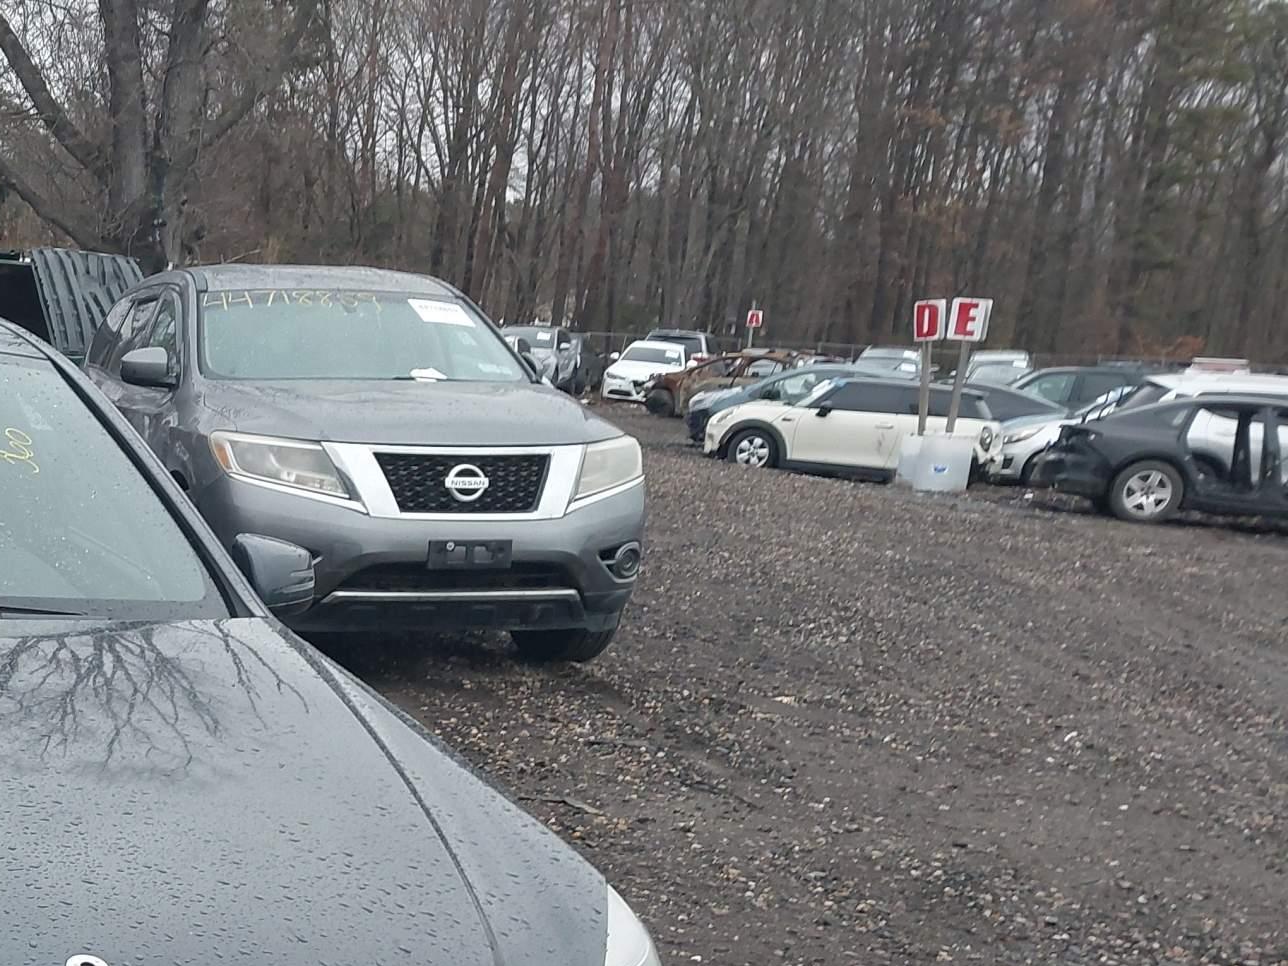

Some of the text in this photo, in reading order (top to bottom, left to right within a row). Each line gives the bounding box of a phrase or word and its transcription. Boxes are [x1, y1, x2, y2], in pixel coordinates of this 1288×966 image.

[916, 304, 940, 338] D
[954, 302, 980, 336] E
[451, 479, 486, 487] NISSAN
